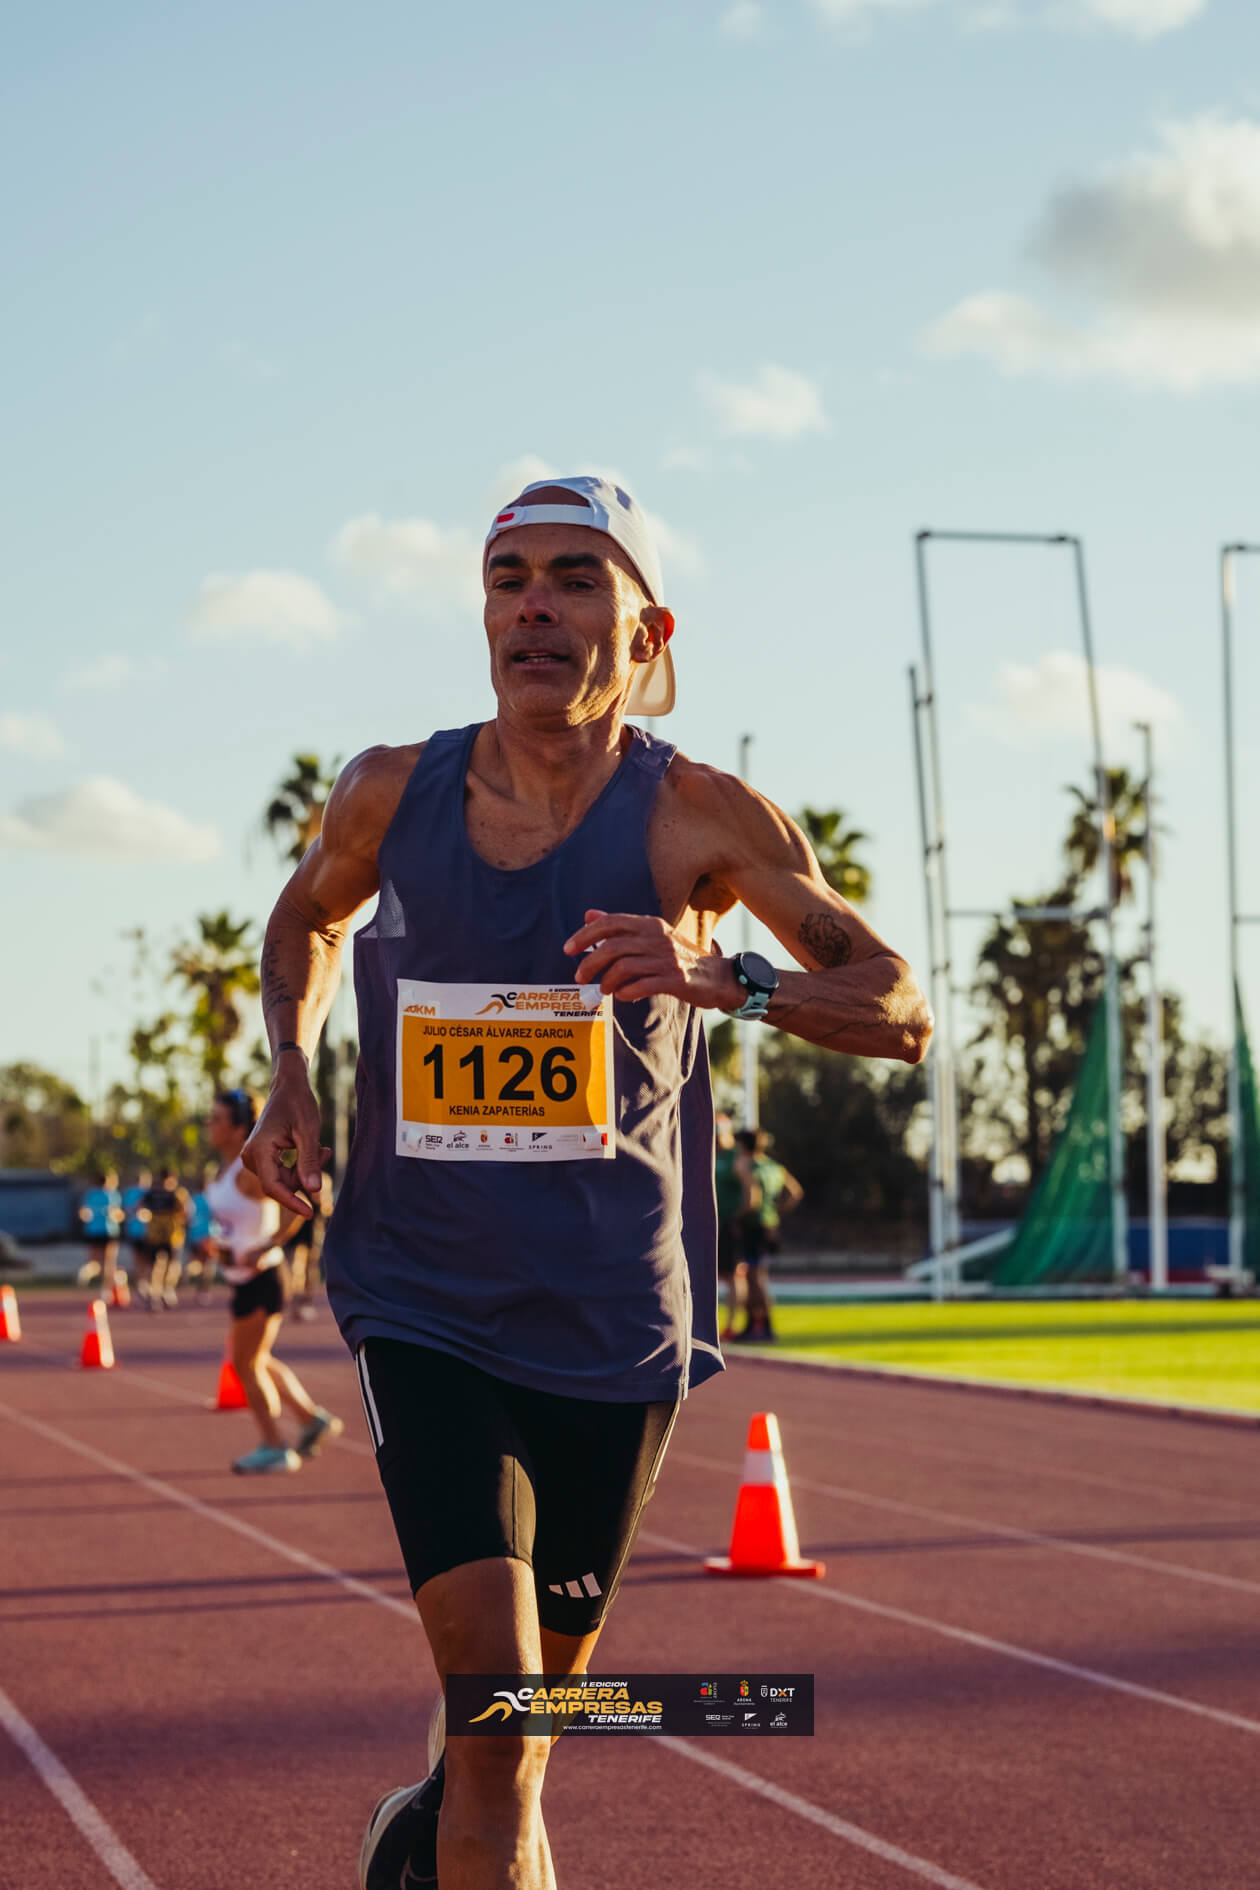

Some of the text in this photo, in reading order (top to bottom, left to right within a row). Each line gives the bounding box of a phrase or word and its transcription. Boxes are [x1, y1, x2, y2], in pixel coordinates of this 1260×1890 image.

[507, 992, 580, 1000] CARRERA
[515, 1001, 604, 1010] EMPRES
[424, 1024, 574, 1038] JULIO CÉSAR ÁLVAREZ GARCIA
[423, 1044, 577, 1102] 1126
[449, 1104, 545, 1116] KENIA ZAPATERÍAS
[425, 1135, 443, 1143] SER
